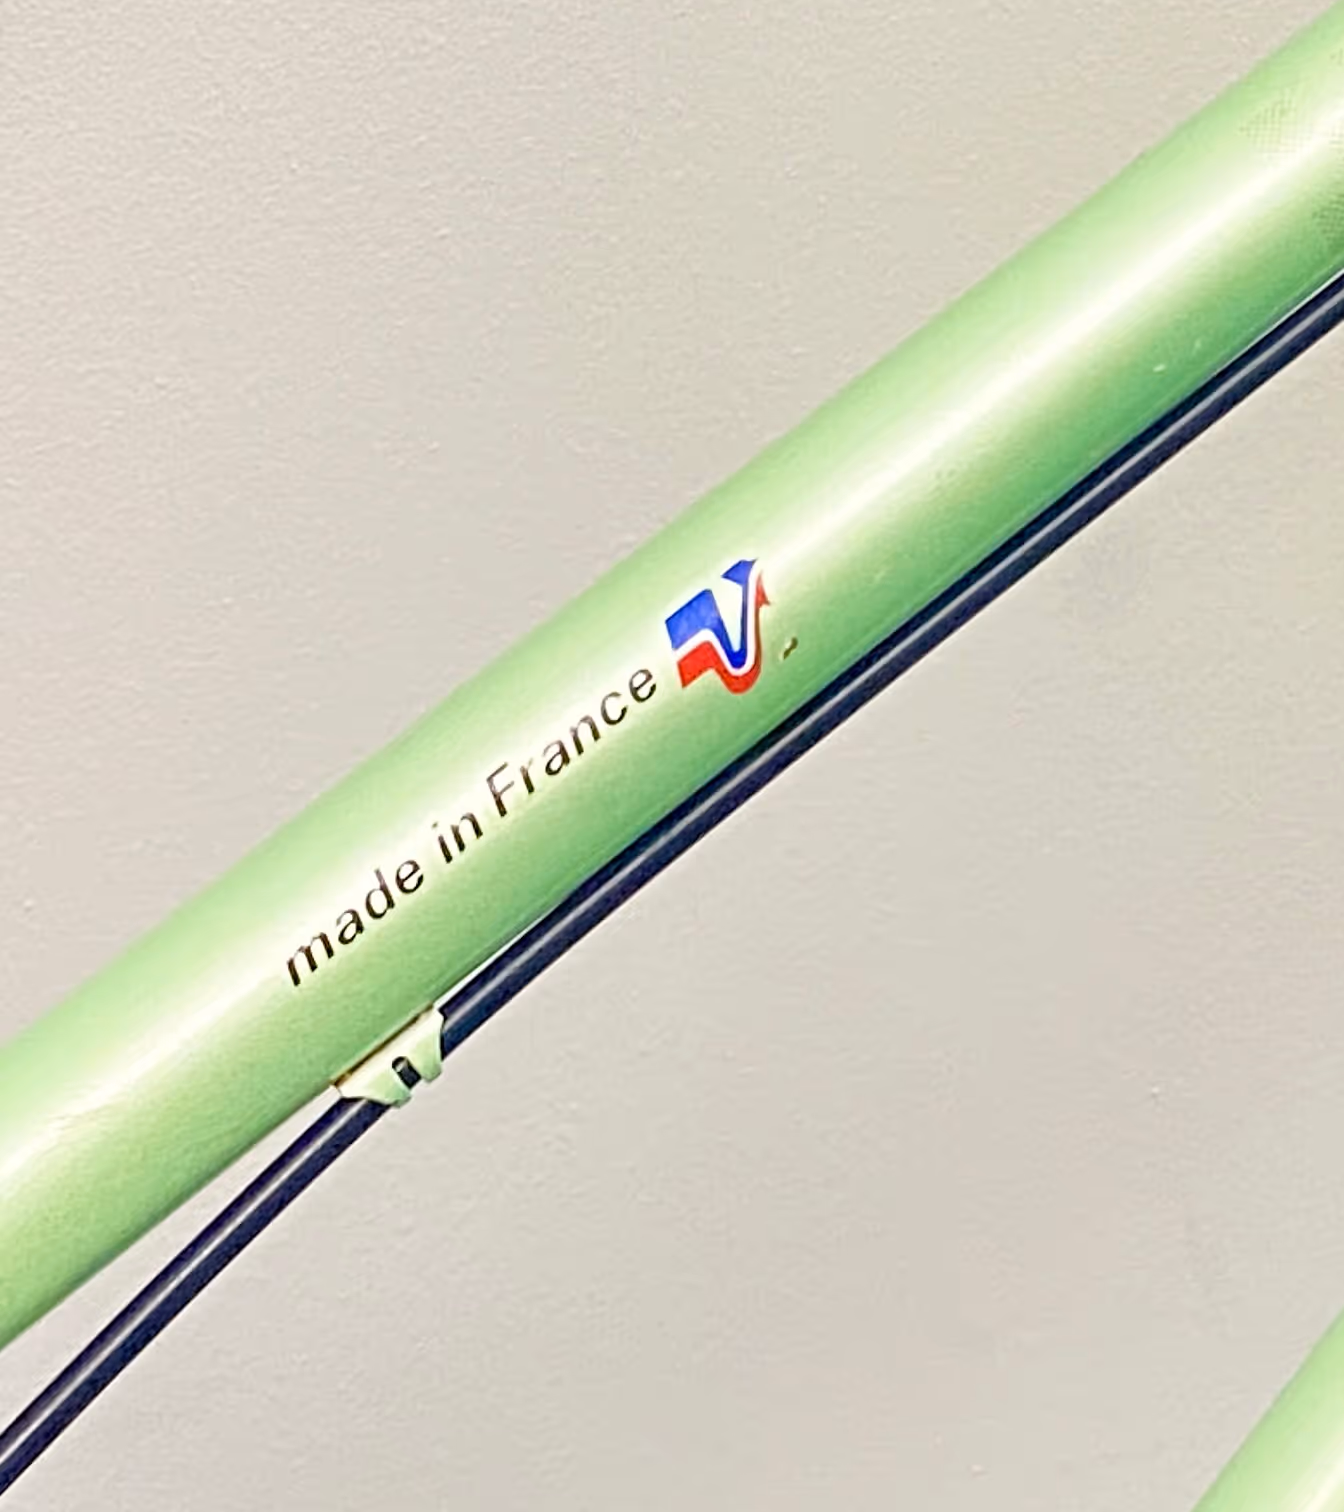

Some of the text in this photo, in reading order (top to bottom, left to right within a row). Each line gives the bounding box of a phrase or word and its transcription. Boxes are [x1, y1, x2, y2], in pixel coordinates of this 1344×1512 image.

[285, 668, 658, 987] made in France
